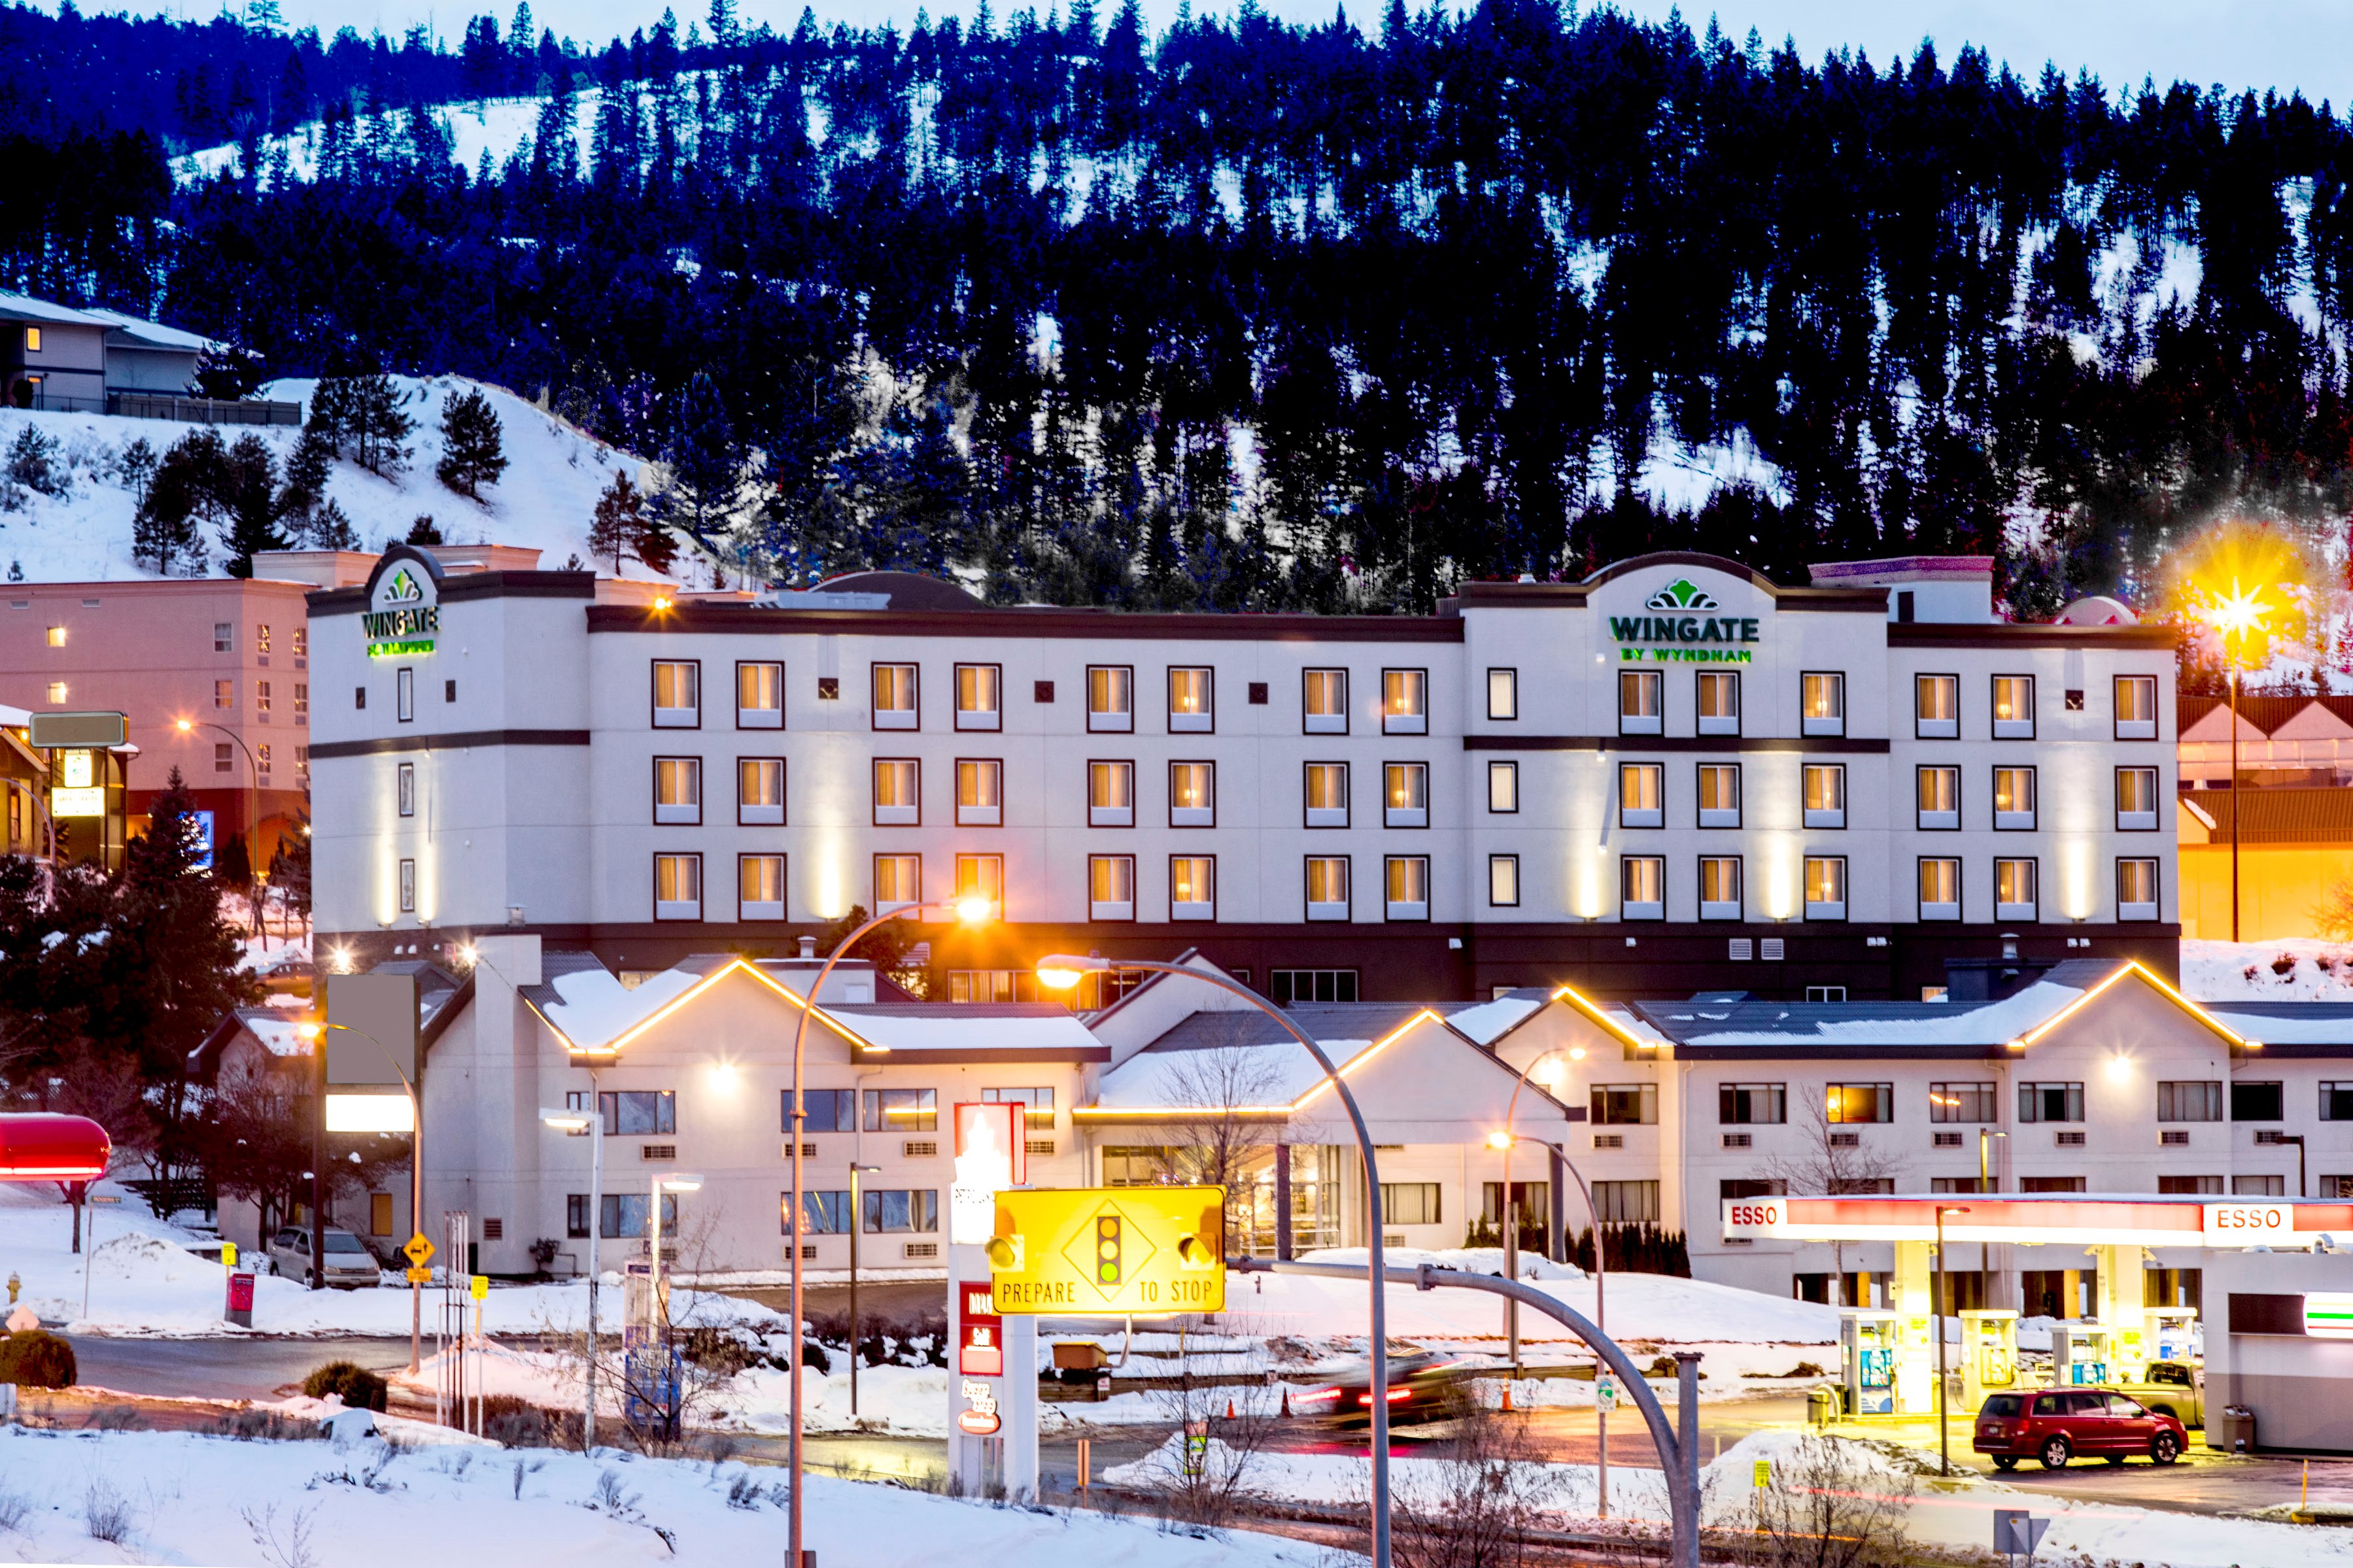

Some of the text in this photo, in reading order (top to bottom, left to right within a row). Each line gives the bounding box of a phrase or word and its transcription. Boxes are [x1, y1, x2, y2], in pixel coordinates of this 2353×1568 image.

[362, 605, 439, 638] WINGATE
[1609, 617, 1759, 642] WINGATE
[1621, 648, 1751, 663] BY WYNDHAM
[1731, 1206, 1777, 1225] ESSO
[2217, 1209, 2281, 1228] ESSO
[1003, 1282, 1075, 1303] PREPARE
[1140, 1282, 1158, 1303] TO
[1171, 1280, 1212, 1303] STOP
